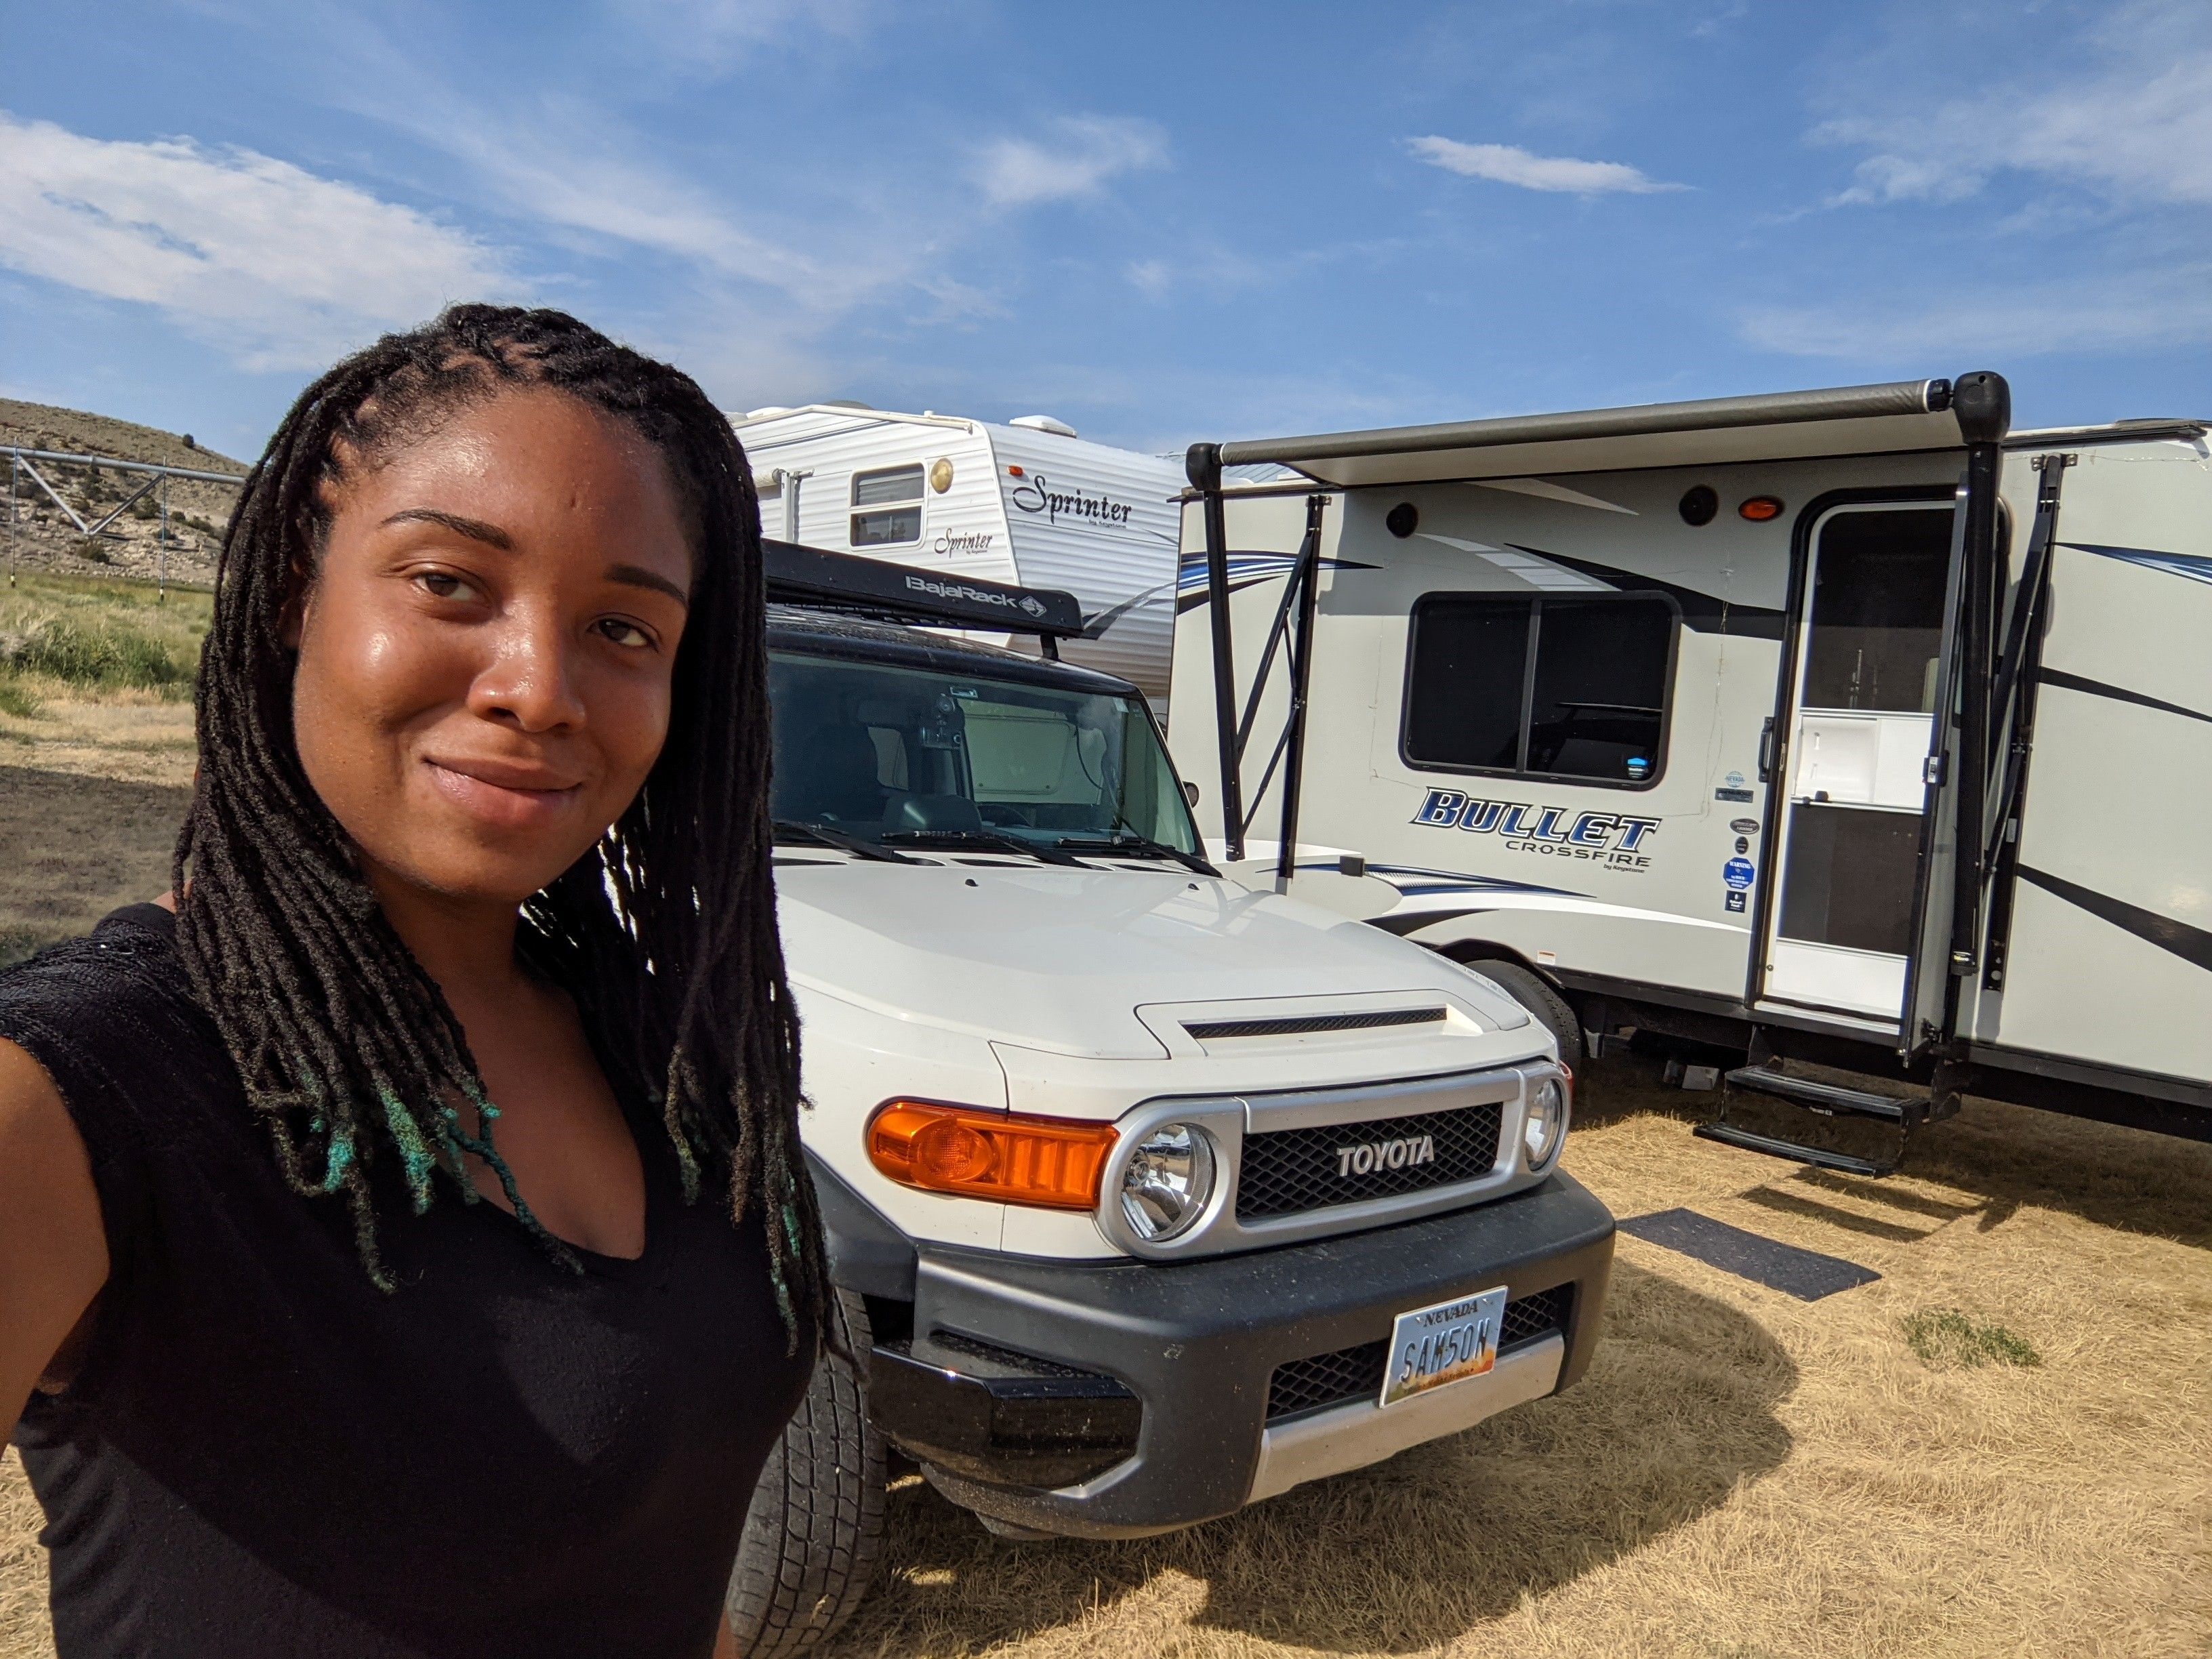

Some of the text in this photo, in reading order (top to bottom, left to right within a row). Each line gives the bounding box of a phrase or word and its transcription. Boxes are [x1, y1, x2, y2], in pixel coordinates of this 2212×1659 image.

[1012, 475, 1132, 525] Sprinter
[934, 527, 993, 559] Sprinter
[905, 575, 1018, 609] BajaRack
[1408, 785, 1663, 853] BULLET
[1505, 840, 1652, 867] CROSSFIRE
[1336, 1134, 1435, 1177] TOYOTA
[1423, 1300, 1478, 1328] NEVADA
